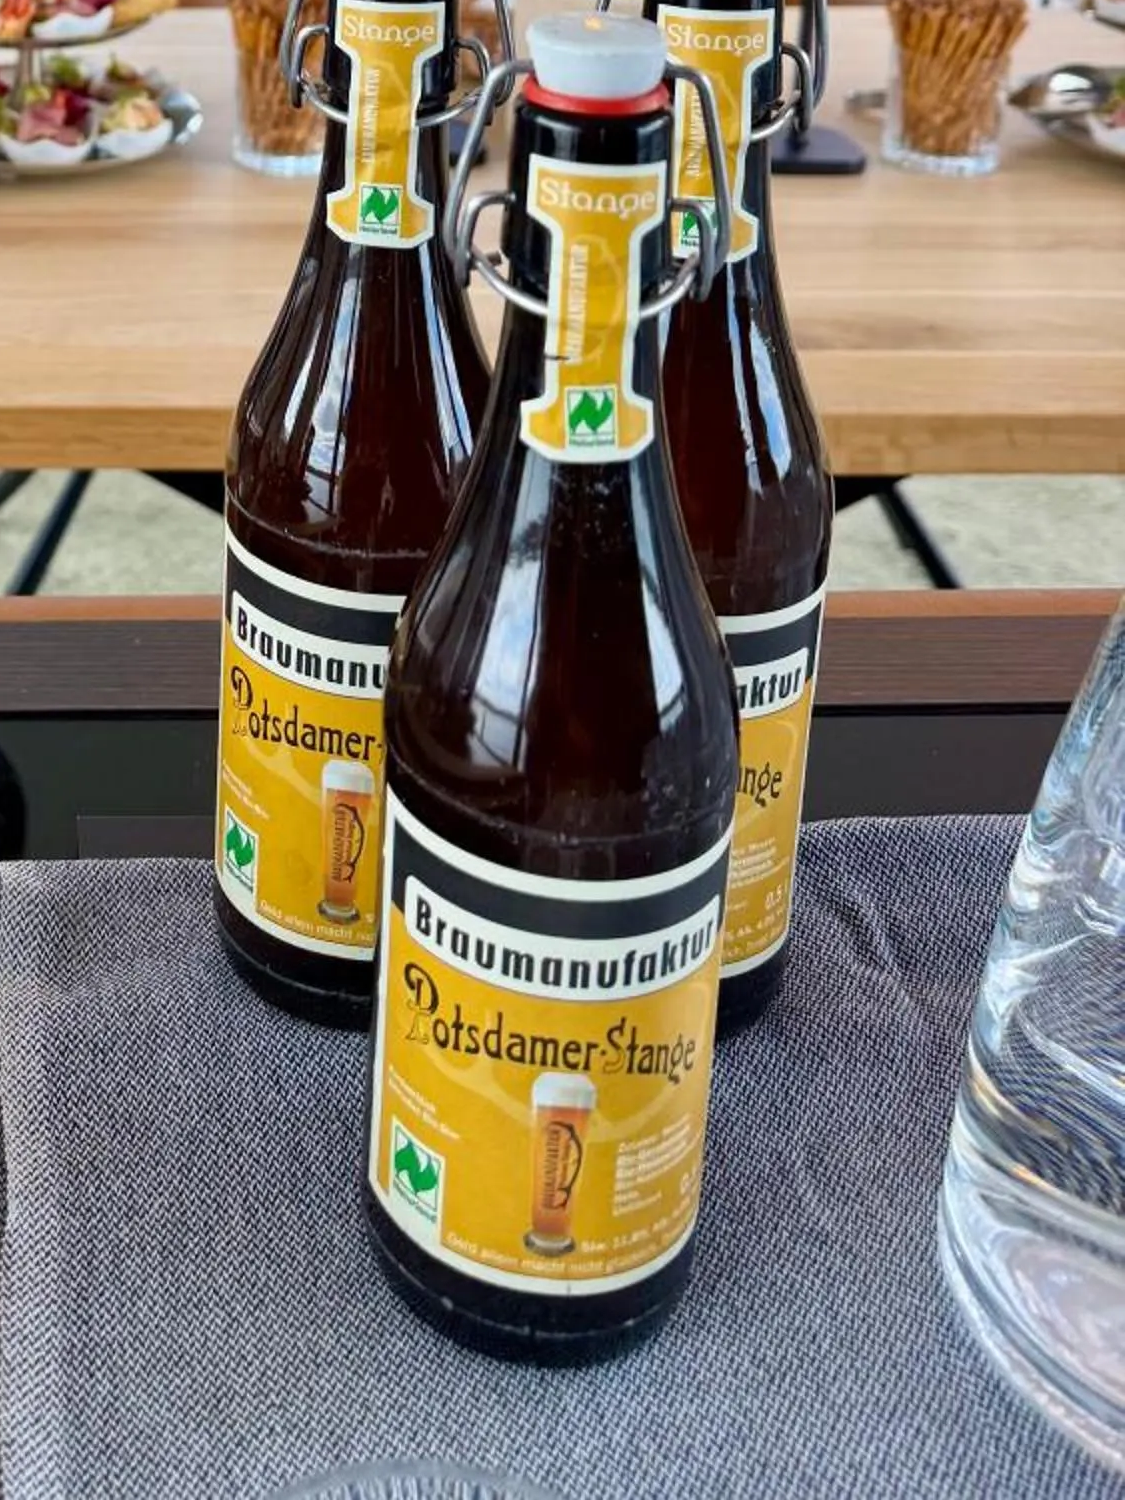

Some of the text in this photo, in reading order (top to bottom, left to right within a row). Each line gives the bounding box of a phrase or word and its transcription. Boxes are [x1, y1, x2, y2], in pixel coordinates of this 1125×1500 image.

[343, 14, 436, 47] Stange
[666, 23, 766, 56] Stange
[538, 175, 656, 219] Stange
[238, 605, 386, 689] Braumanu
[415, 893, 715, 990] Braumanufaktur
